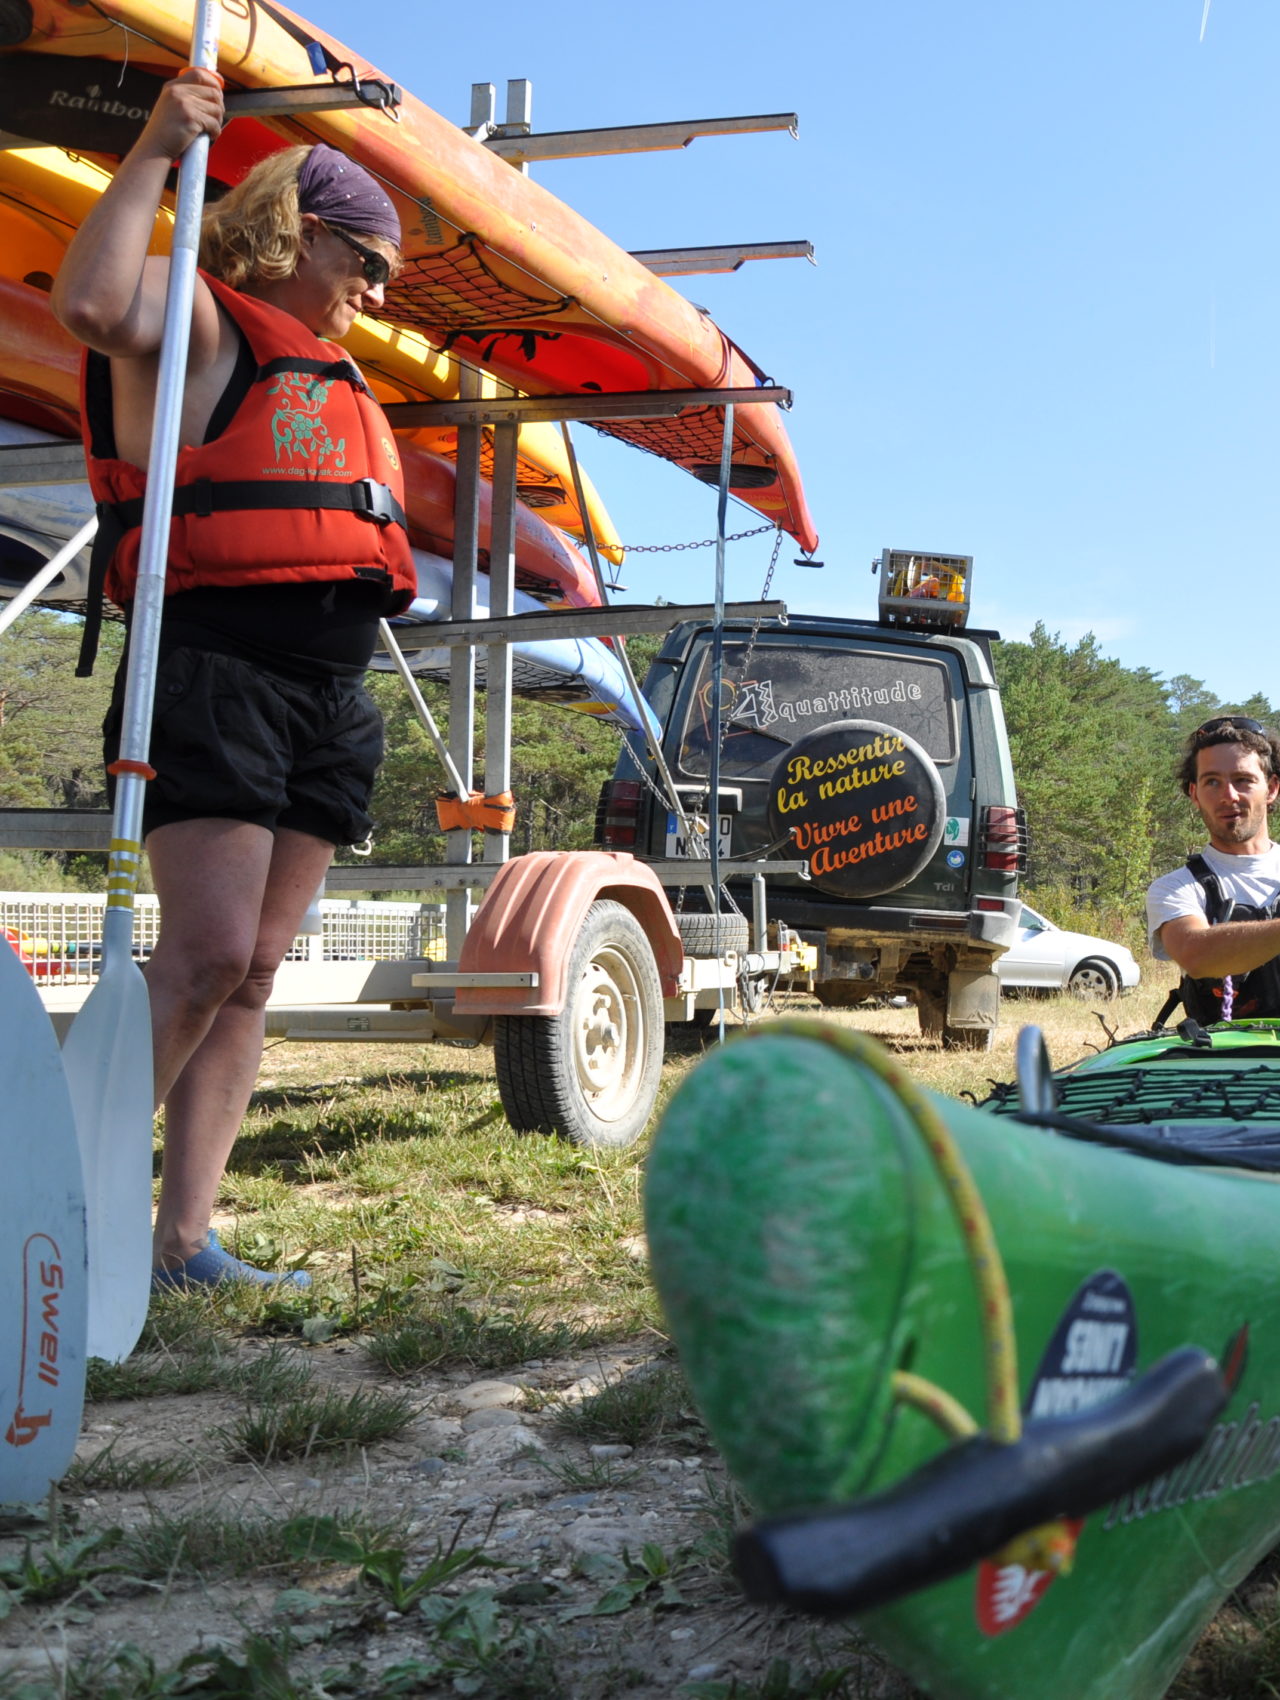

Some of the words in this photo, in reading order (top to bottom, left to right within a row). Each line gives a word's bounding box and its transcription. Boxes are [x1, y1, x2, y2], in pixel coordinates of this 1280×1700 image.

[731, 679, 922, 729] Aquattitude
[787, 733, 907, 785] Ressentir
[777, 787, 808, 814] la
[818, 759, 906, 801] nature
[790, 815, 863, 850] Vivre
[871, 795, 919, 825] une
[810, 823, 929, 877] Aventure
